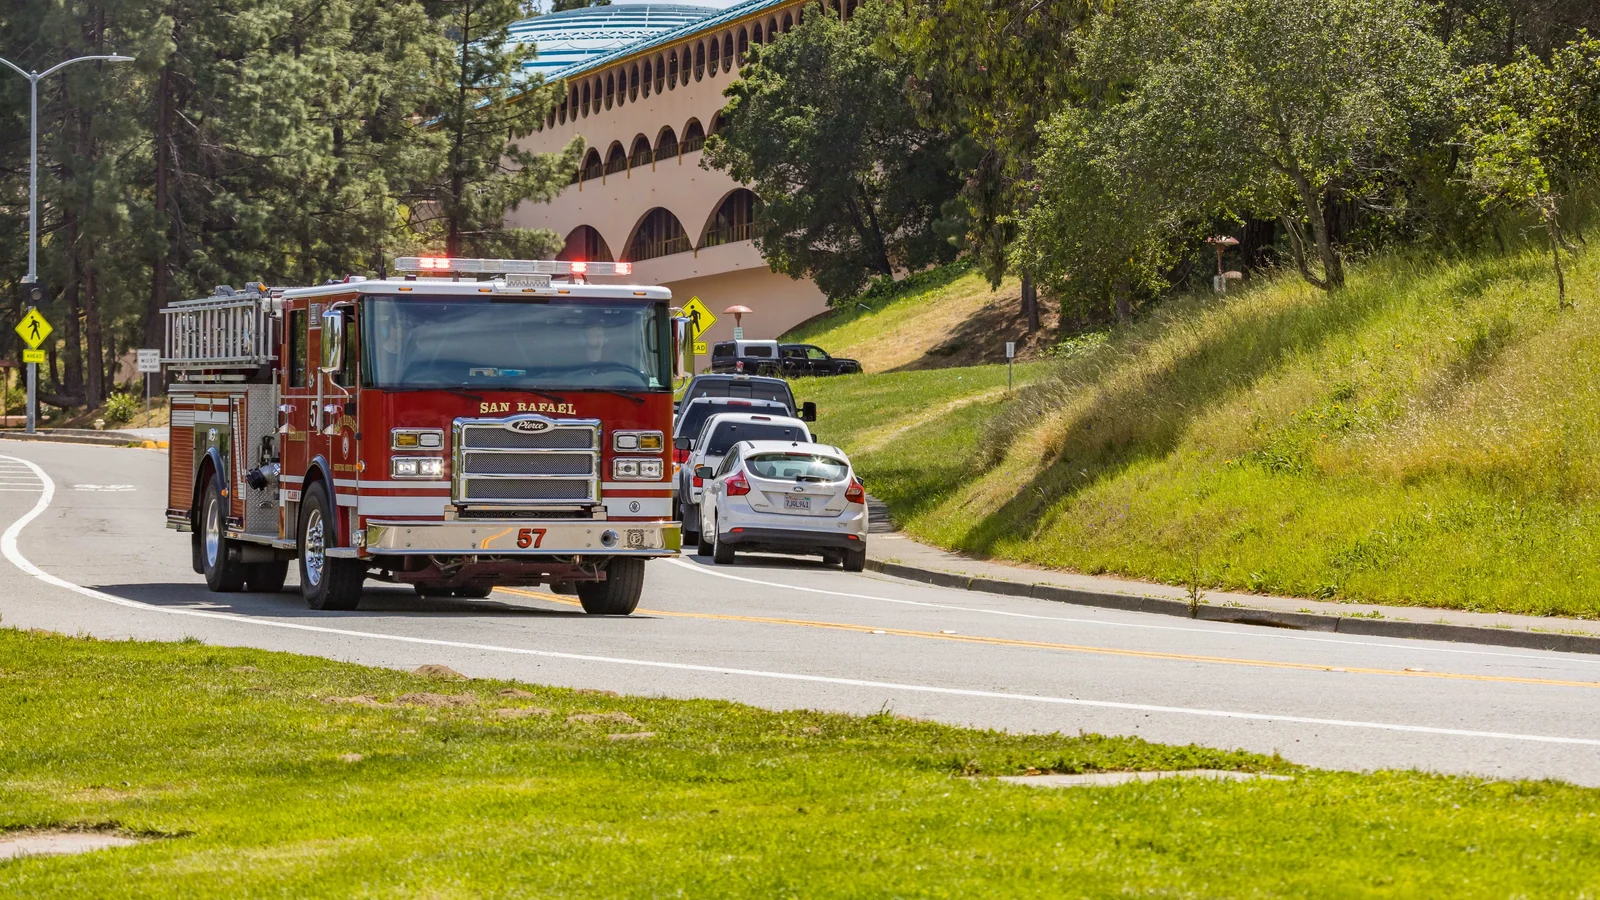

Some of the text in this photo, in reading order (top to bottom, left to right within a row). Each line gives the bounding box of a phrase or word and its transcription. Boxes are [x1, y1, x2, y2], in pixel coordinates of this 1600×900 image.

[480, 402, 577, 415] SAN RAFAEL
[516, 421, 544, 430] Pierce
[516, 528, 546, 548] 57
